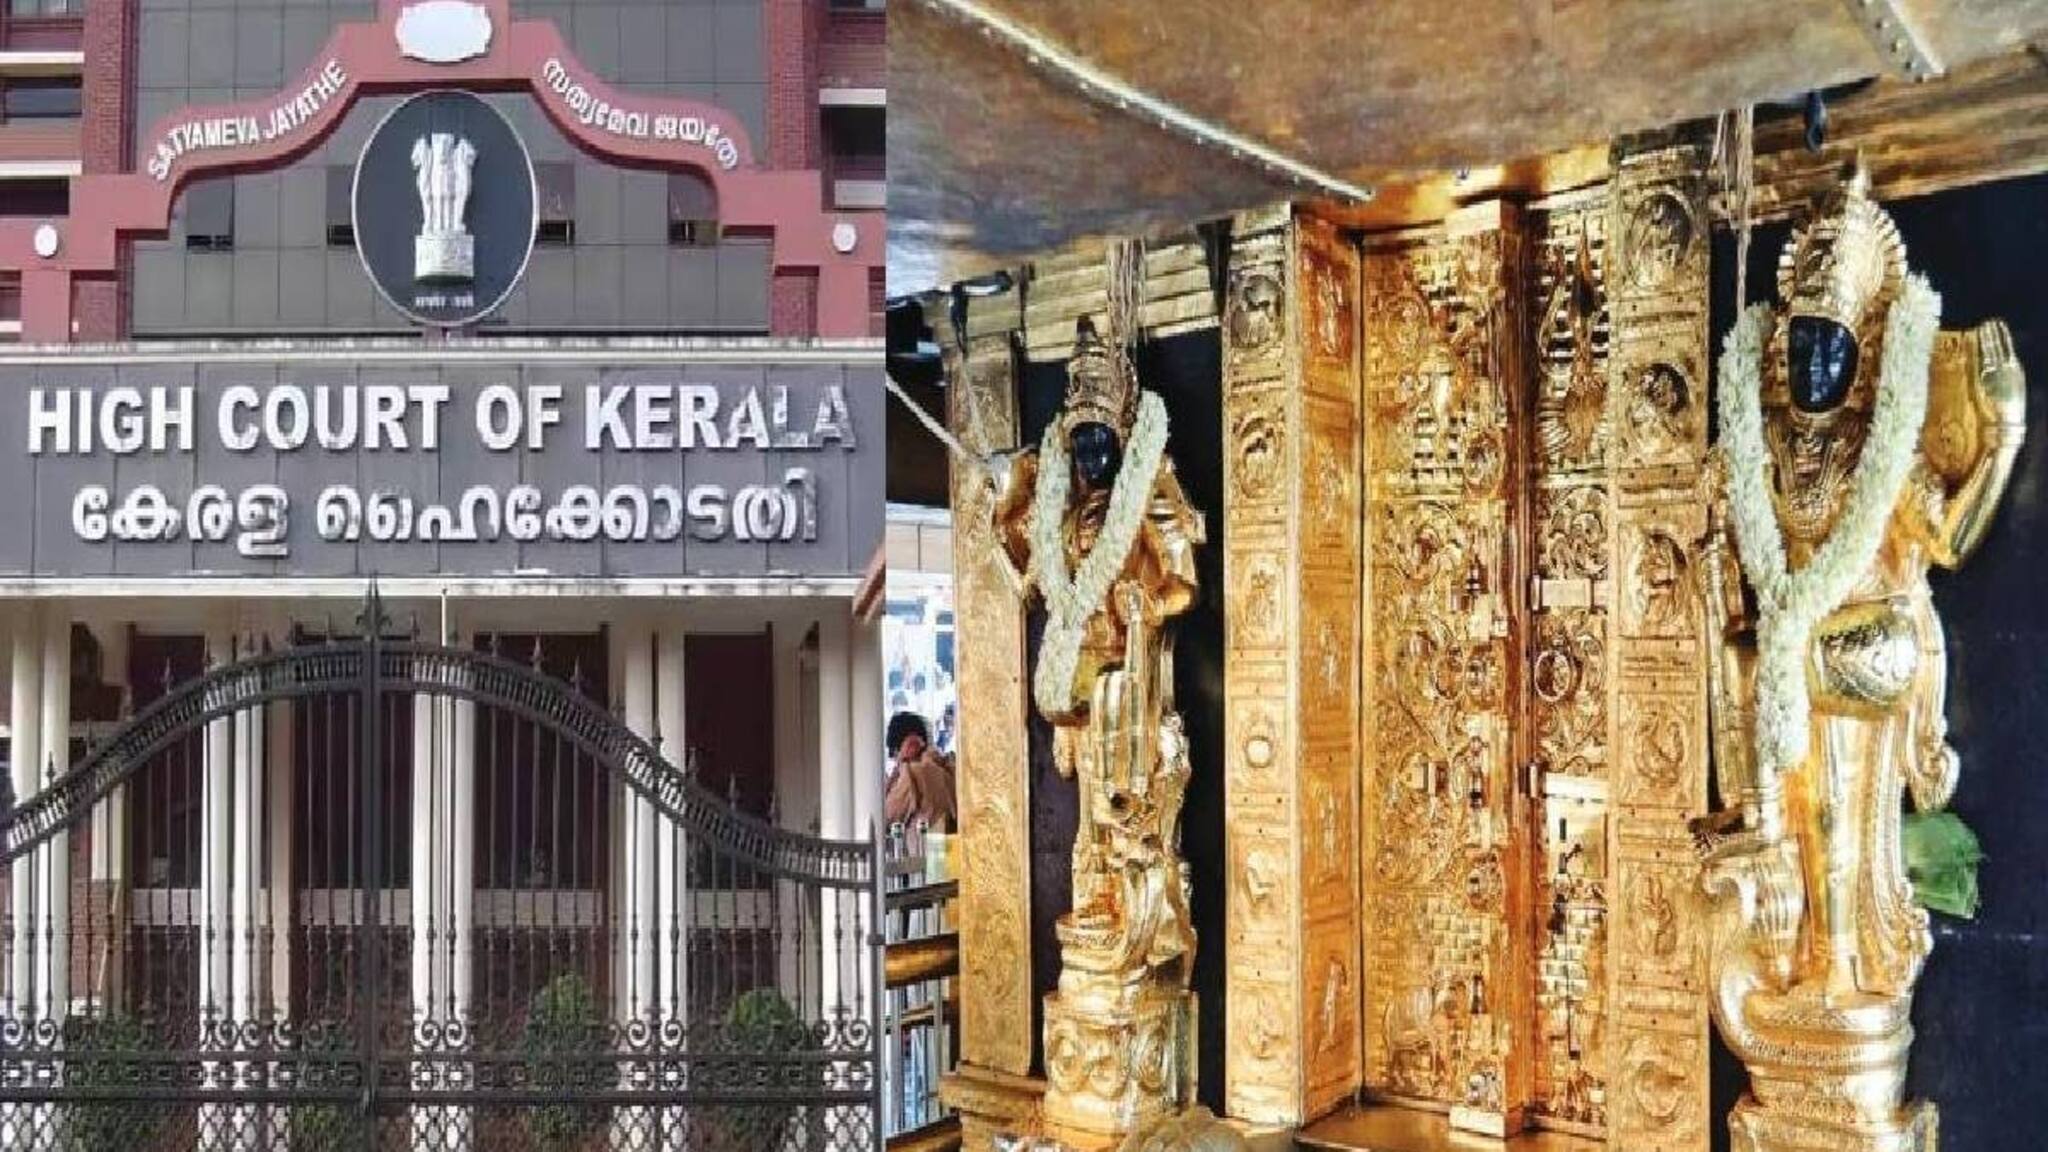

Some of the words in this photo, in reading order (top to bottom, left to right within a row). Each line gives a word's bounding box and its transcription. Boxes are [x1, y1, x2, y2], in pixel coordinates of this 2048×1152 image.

[149, 116, 260, 181] SATYAMEVA
[263, 59, 347, 139] JAYATHE
[28, 386, 195, 453] HIGH
[218, 384, 449, 450] COURT
[475, 385, 563, 450] OF
[585, 385, 856, 449] KERALA
[72, 484, 289, 556] കേരള
[316, 467, 817, 541] ഹൈക്കോടതി
